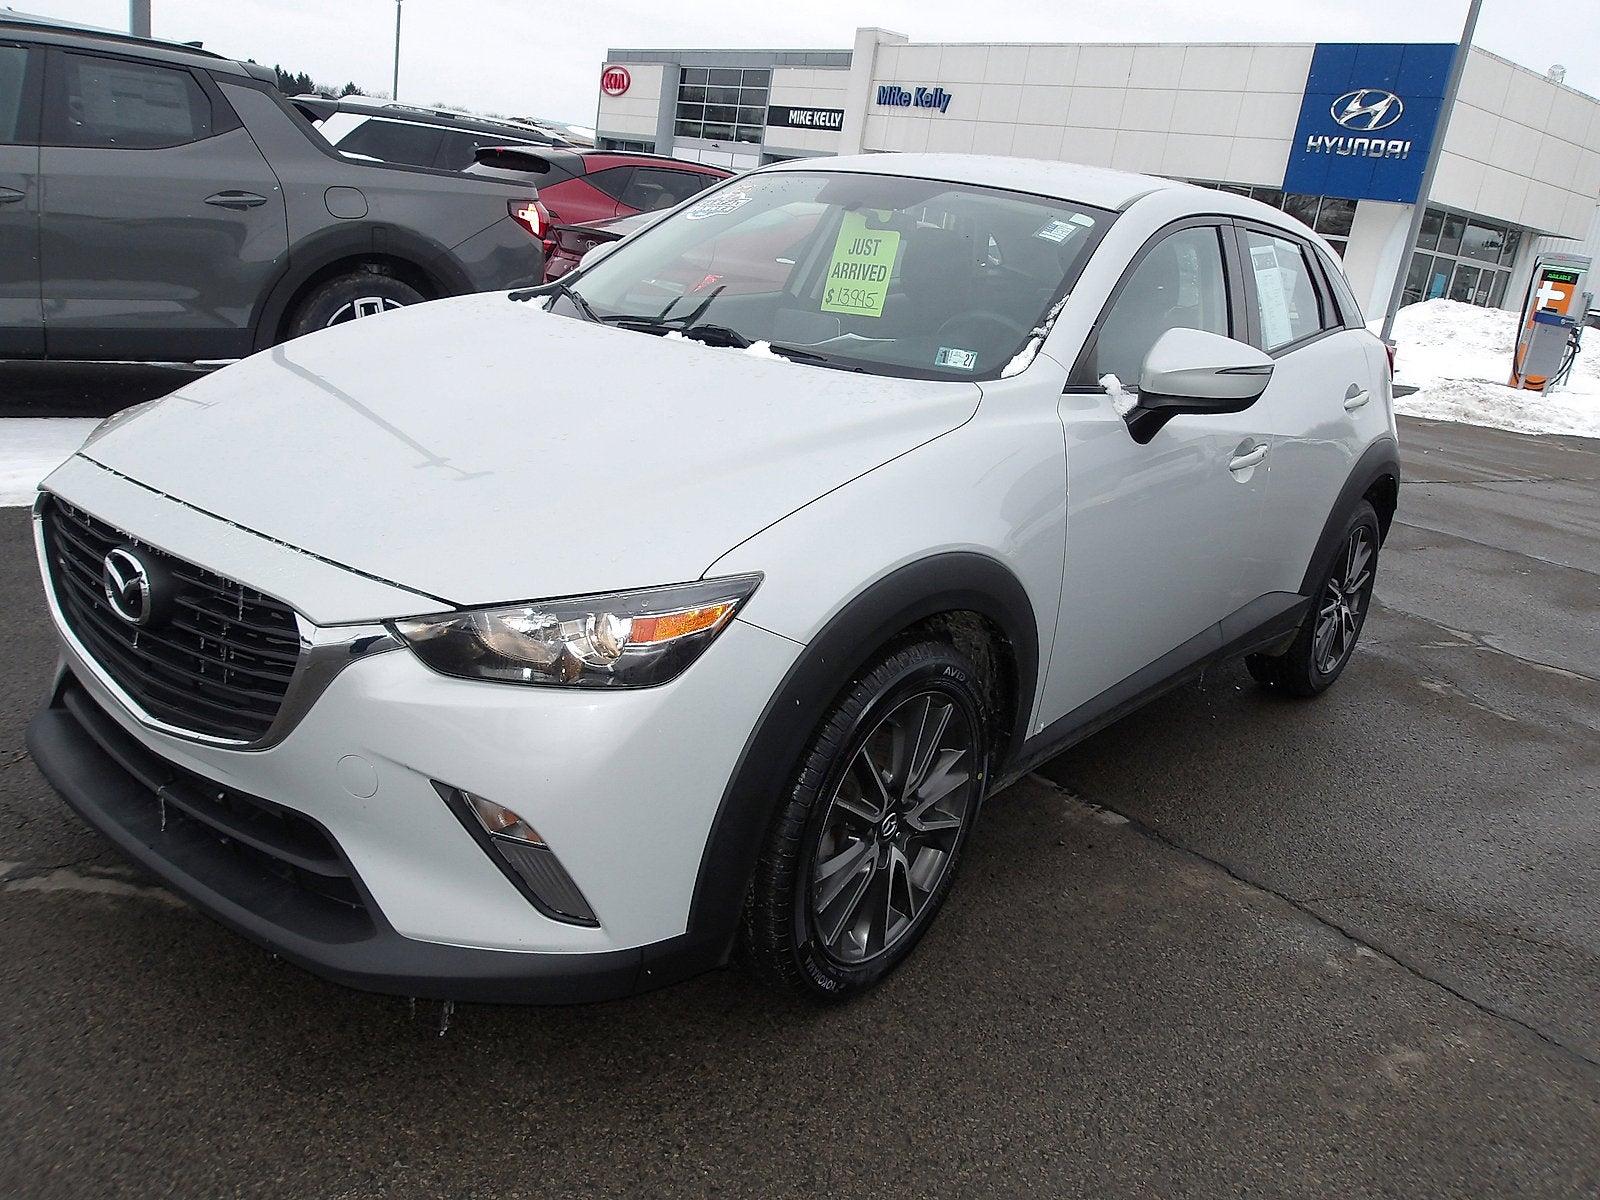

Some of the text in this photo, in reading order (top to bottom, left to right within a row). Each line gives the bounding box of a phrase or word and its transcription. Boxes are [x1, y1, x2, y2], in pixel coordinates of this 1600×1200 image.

[876, 85, 953, 114] Mike Kelly
[788, 109, 843, 128] MIKE KELLY
[1305, 134, 1413, 160] HYUNDAI
[848, 237, 882, 257] JUST
[831, 261, 887, 282] ARRIVED
[963, 353, 975, 367] 27
[942, 665, 967, 682] AVID
